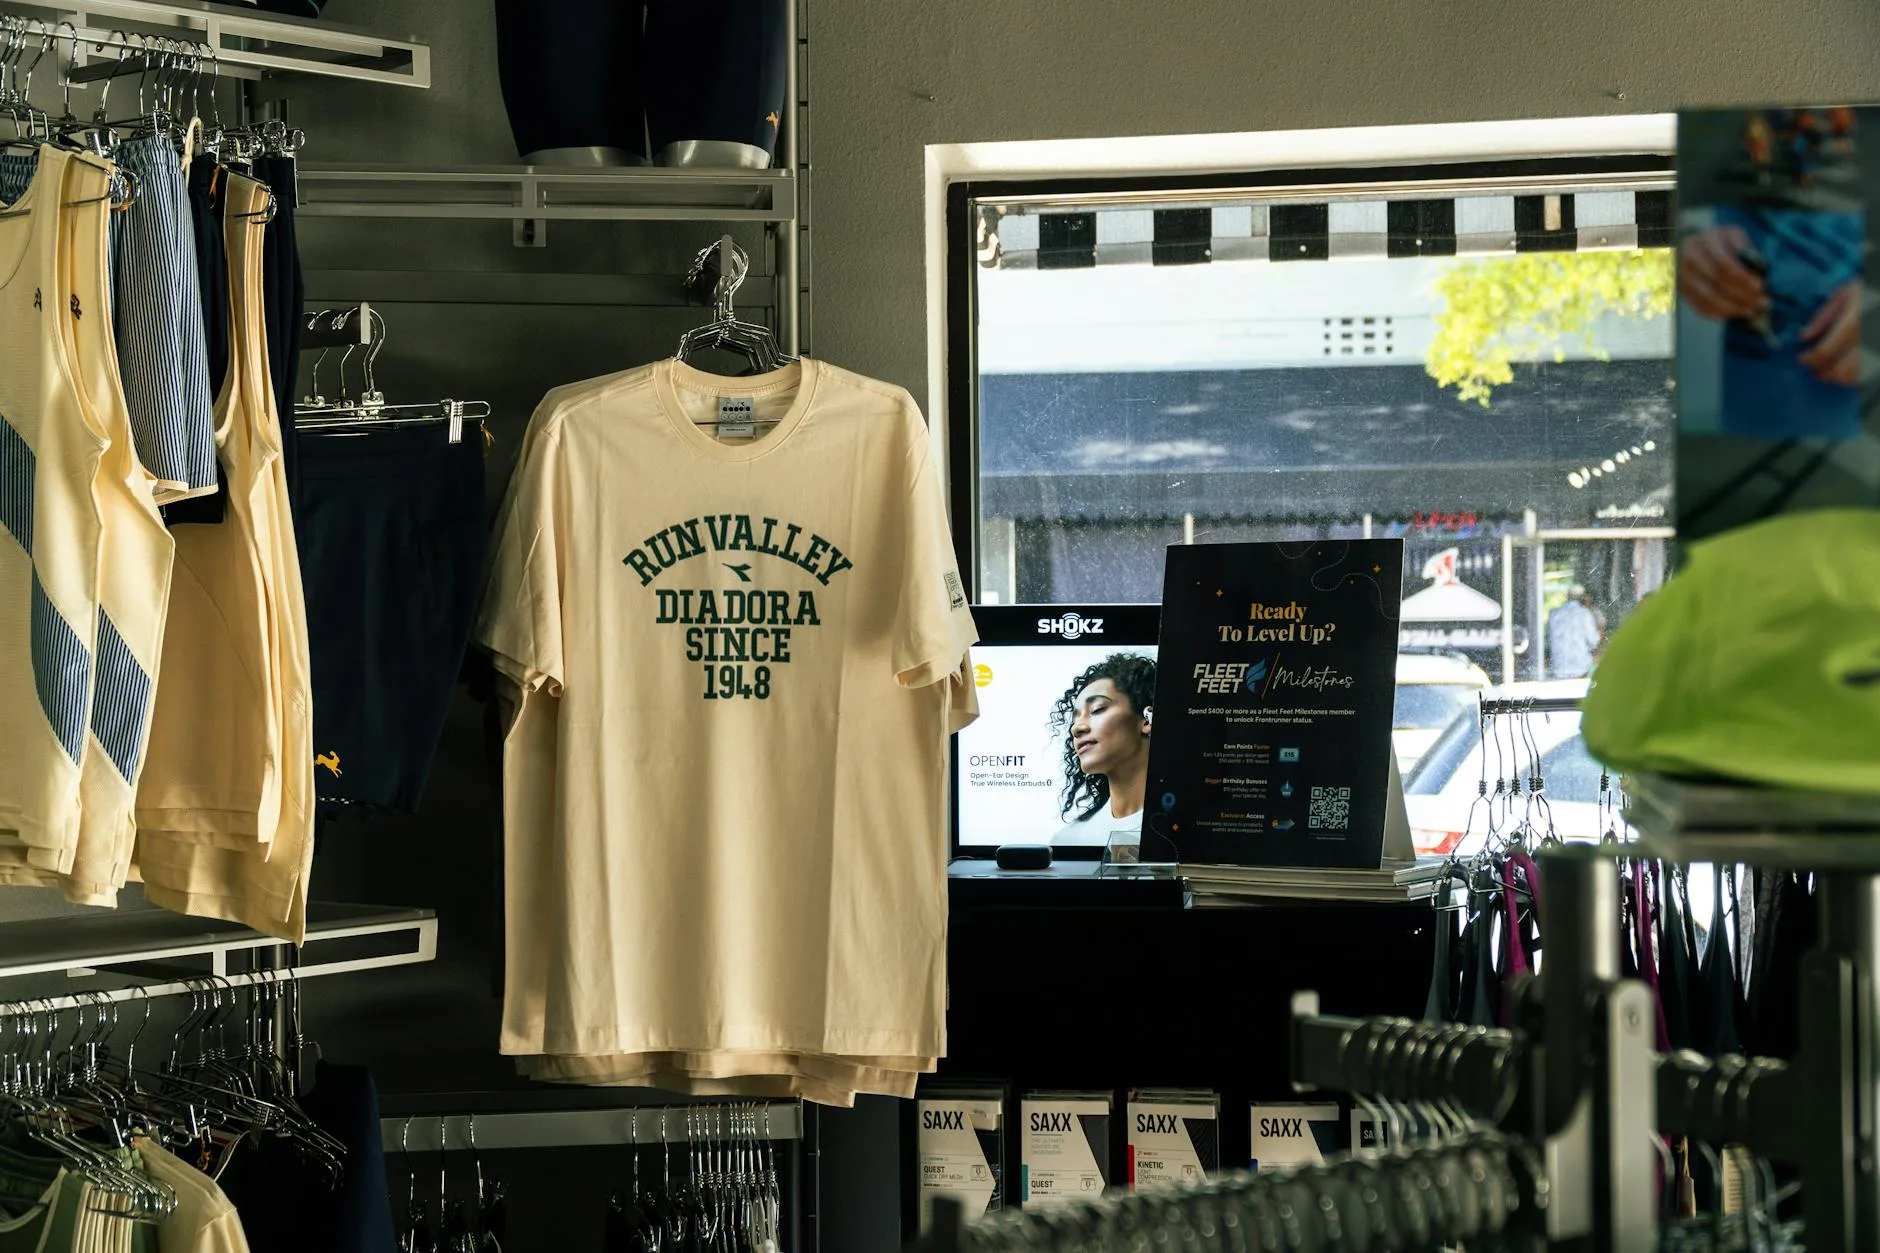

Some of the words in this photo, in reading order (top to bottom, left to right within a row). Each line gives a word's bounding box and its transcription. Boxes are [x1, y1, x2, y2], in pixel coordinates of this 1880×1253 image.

[655, 589, 821, 626] DIADORA
[1250, 601, 1307, 623] Ready
[1037, 616, 1104, 635] SHOKZ
[1218, 625, 1242, 642] To
[1247, 624, 1294, 642] Level
[1299, 623, 1336, 645] Up?
[685, 627, 791, 663] SINCE
[1193, 663, 1249, 679] FLEET
[1273, 665, 1355, 693] Milestones
[703, 665, 771, 700] 1948
[1197, 678, 1244, 694] FEET
[1188, 707, 1207, 716] Spend
[1208, 707, 1224, 715] $400
[1294, 708, 1328, 716] Milestones
[970, 755, 1026, 767] OPENFIT
[970, 772, 1004, 780] Open-Ear
[1005, 772, 1029, 780] Design
[1223, 777, 1245, 785] Birthday
[923, 1110, 964, 1130] SAXX
[1030, 1112, 1072, 1132] SAXX
[1137, 1113, 1178, 1134] SAXX
[1260, 1118, 1303, 1138] SAXX
[923, 1165, 945, 1174] QUEST
[1137, 1160, 1164, 1169] KINETIC
[1031, 1180, 1054, 1188] QUEST
